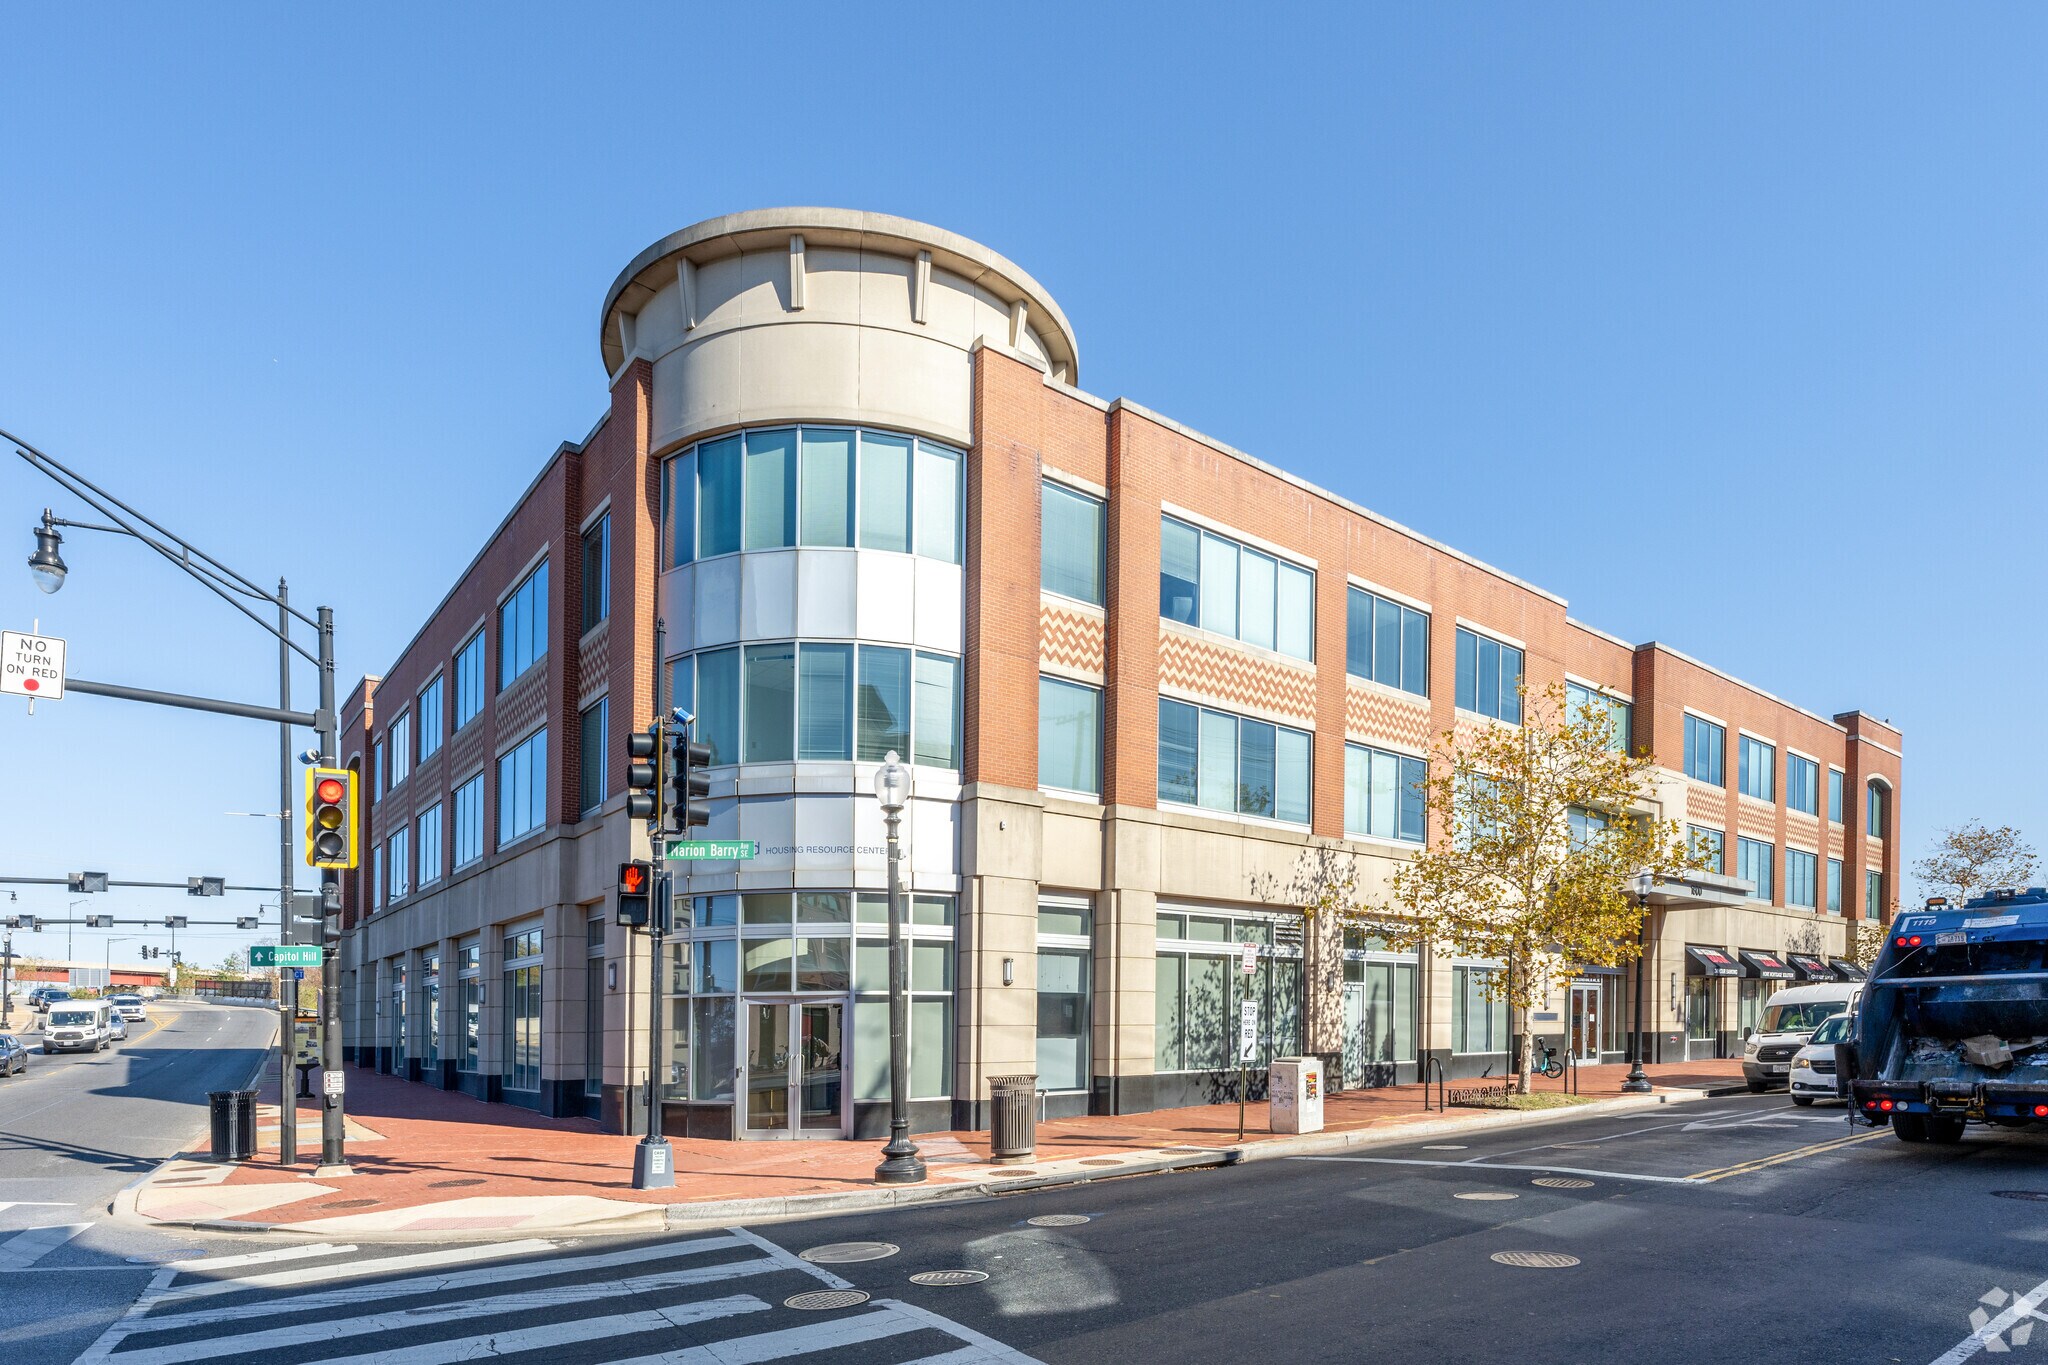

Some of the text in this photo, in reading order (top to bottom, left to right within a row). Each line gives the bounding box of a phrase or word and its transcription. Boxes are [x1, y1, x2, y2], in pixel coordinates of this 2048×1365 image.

[20, 638, 47, 652] NO
[16, 652, 51, 665] TURN
[6, 663, 58, 679] ON RED
[670, 843, 706, 857] Marion
[710, 844, 739, 860] Barry
[740, 842, 749, 850] Ave
[765, 846, 804, 855] HOUSING
[806, 845, 855, 854] RESOURCE
[740, 849, 749, 858] SE
[1912, 918, 1937, 927] 1119
[268, 951, 317, 963] Capitol Hill
[1244, 1006, 1256, 1016] STOP
[1244, 1028, 1254, 1039] RED
